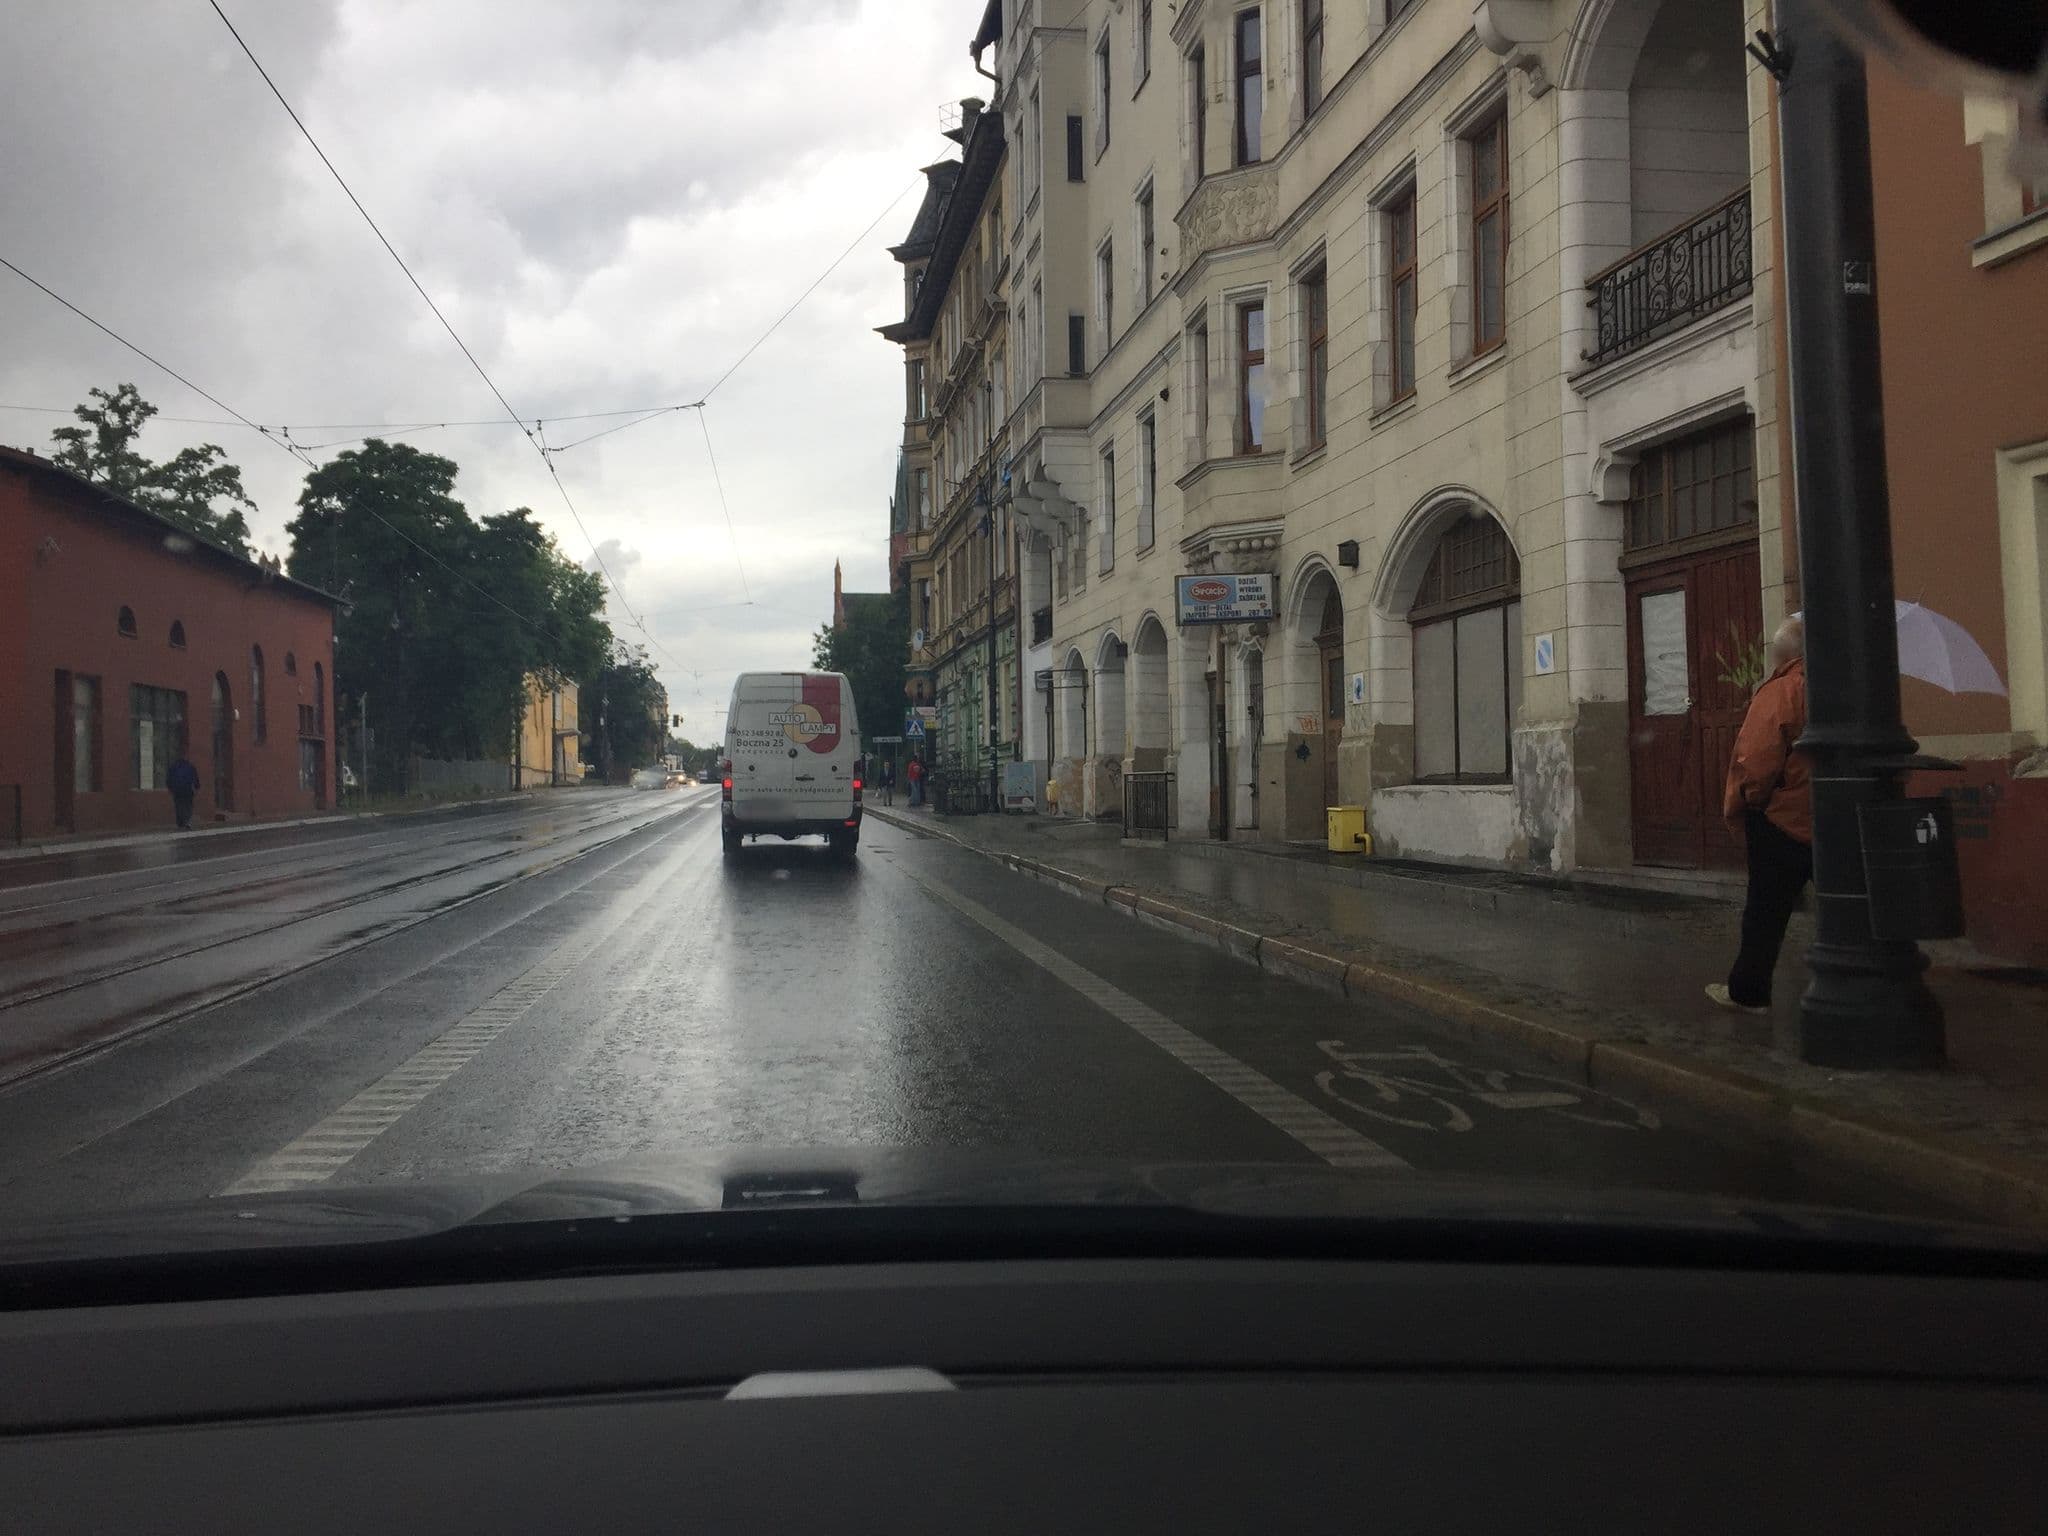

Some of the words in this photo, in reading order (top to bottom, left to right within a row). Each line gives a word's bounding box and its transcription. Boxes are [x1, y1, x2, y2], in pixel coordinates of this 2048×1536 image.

[773, 714, 801, 723] AUTO
[801, 724, 834, 733] LAMPY
[736, 738, 770, 747] Boczna
[772, 738, 784, 747] 25
